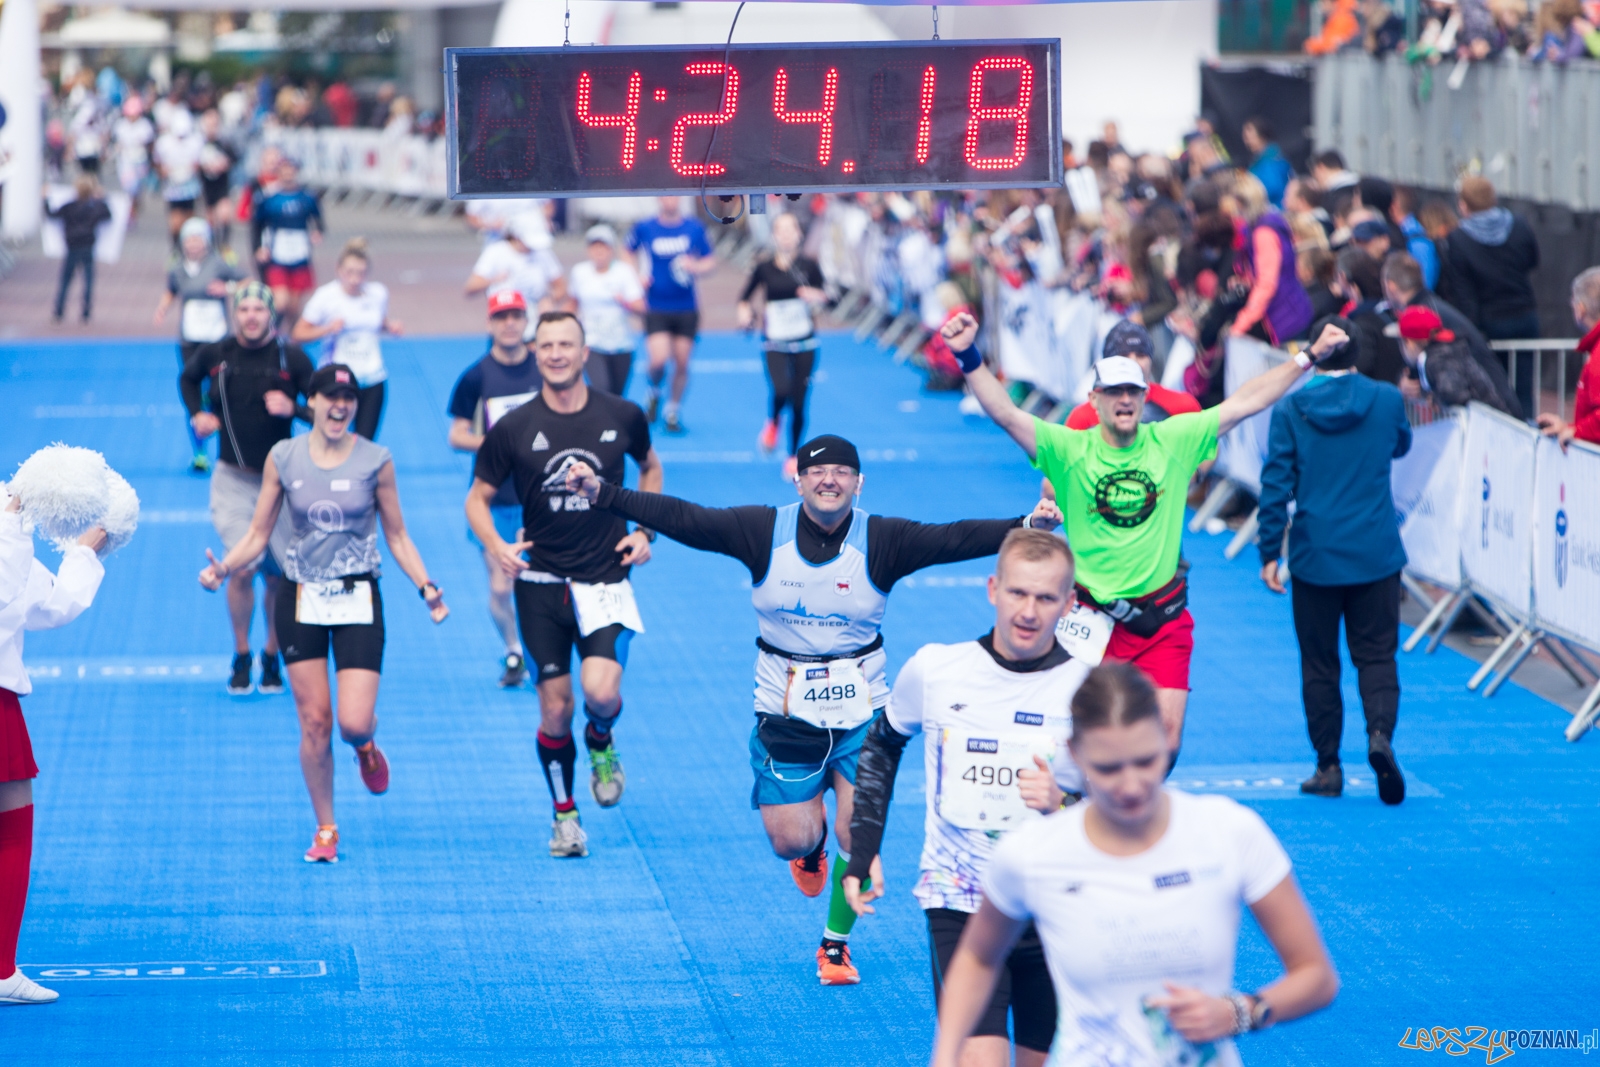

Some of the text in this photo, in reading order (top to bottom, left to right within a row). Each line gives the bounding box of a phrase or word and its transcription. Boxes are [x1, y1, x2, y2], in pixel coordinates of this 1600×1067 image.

[780, 617, 813, 626] TUREK
[1058, 617, 1091, 639] 3159
[804, 684, 856, 702] 4498
[40, 966, 186, 977] PKO
